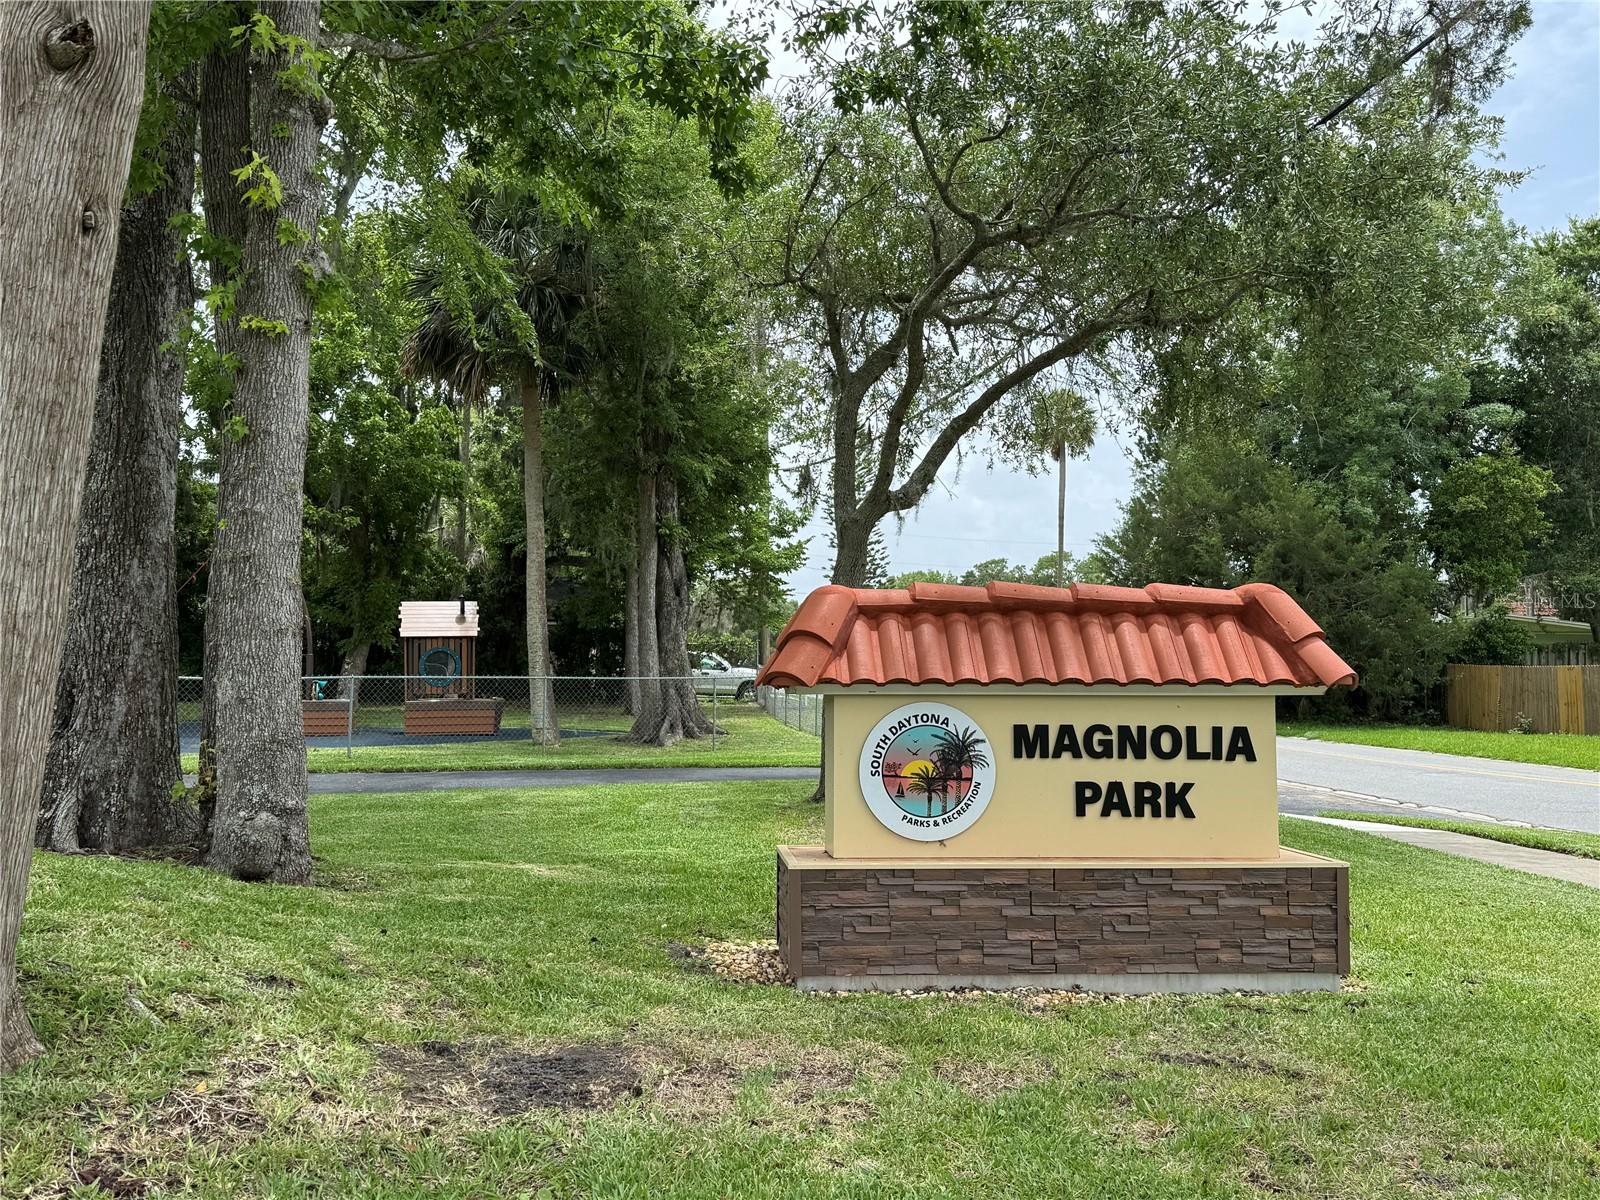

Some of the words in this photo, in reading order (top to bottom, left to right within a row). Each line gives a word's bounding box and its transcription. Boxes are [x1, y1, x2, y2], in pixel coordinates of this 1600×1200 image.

[870, 734, 891, 777] SOUTH
[888, 713, 951, 738] DAYTONA
[1013, 724, 1257, 761] MAGNOLIA
[901, 814, 932, 828] PARKS
[933, 819, 940, 828] &
[942, 781, 982, 826] RECREATION
[1075, 781, 1196, 818] PARK
